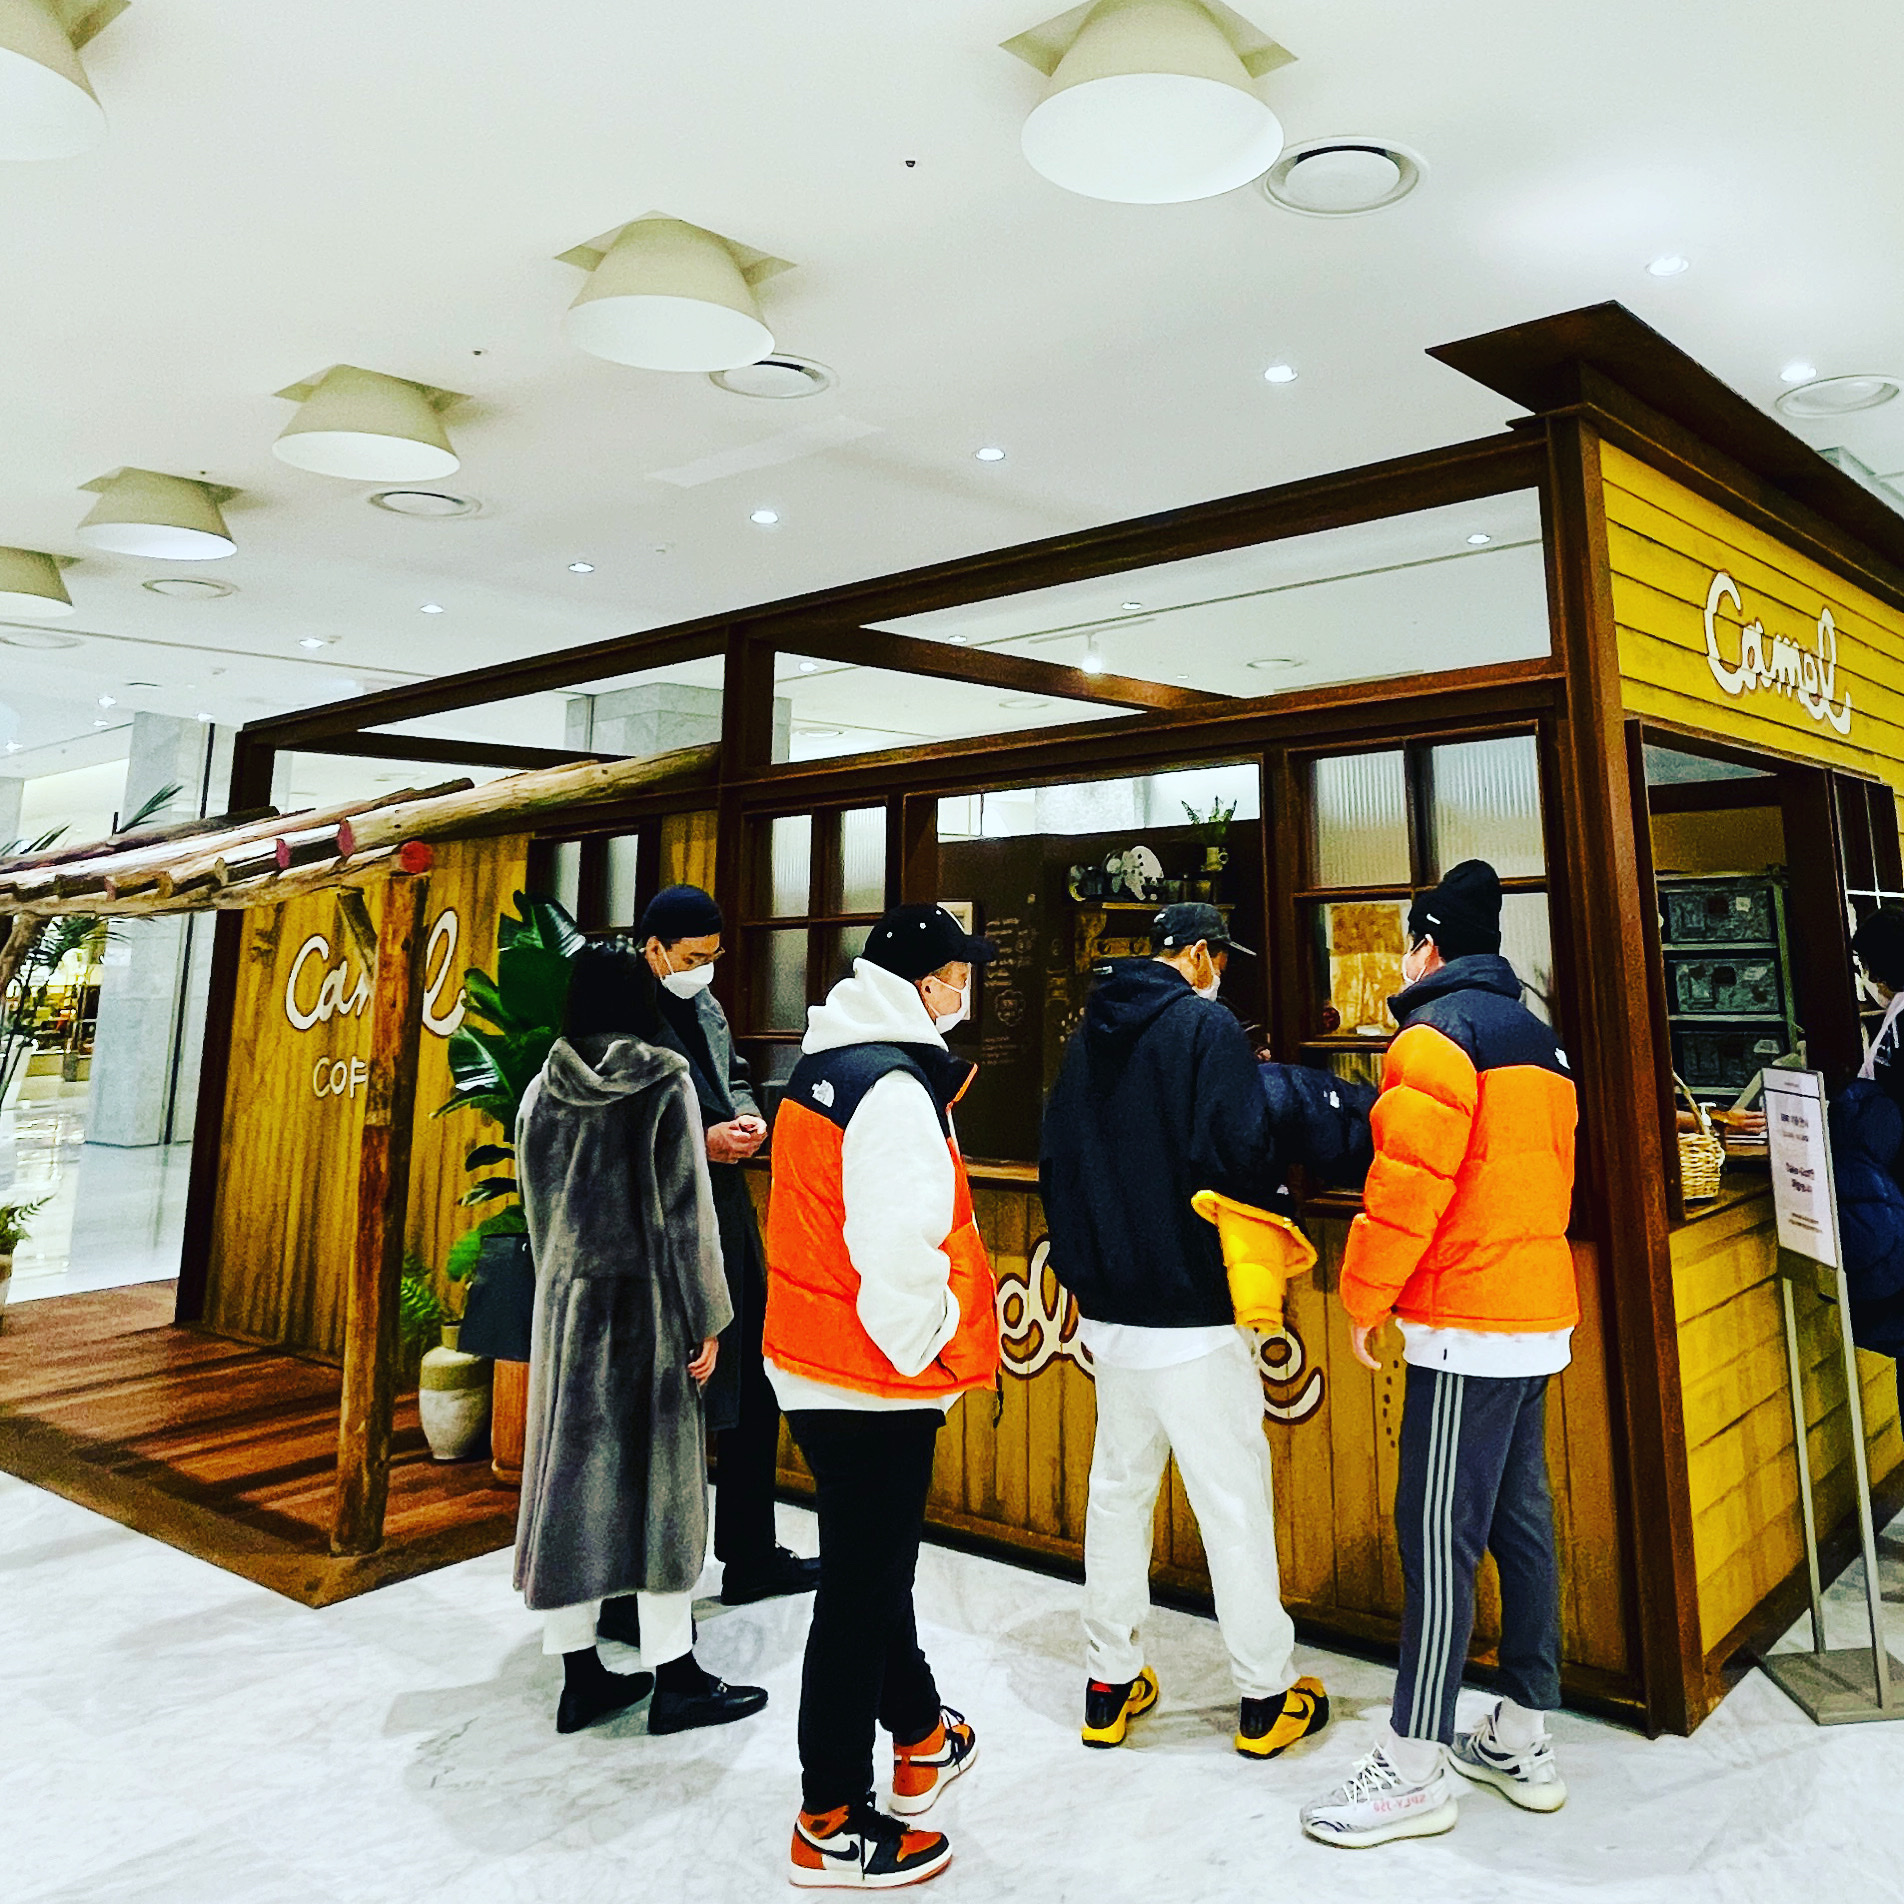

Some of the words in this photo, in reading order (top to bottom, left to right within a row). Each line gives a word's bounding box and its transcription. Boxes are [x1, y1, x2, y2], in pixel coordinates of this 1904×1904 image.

[1704, 571, 1851, 734] Camel
[285, 910, 466, 1036] Cal
[313, 1056, 368, 1098] COF
